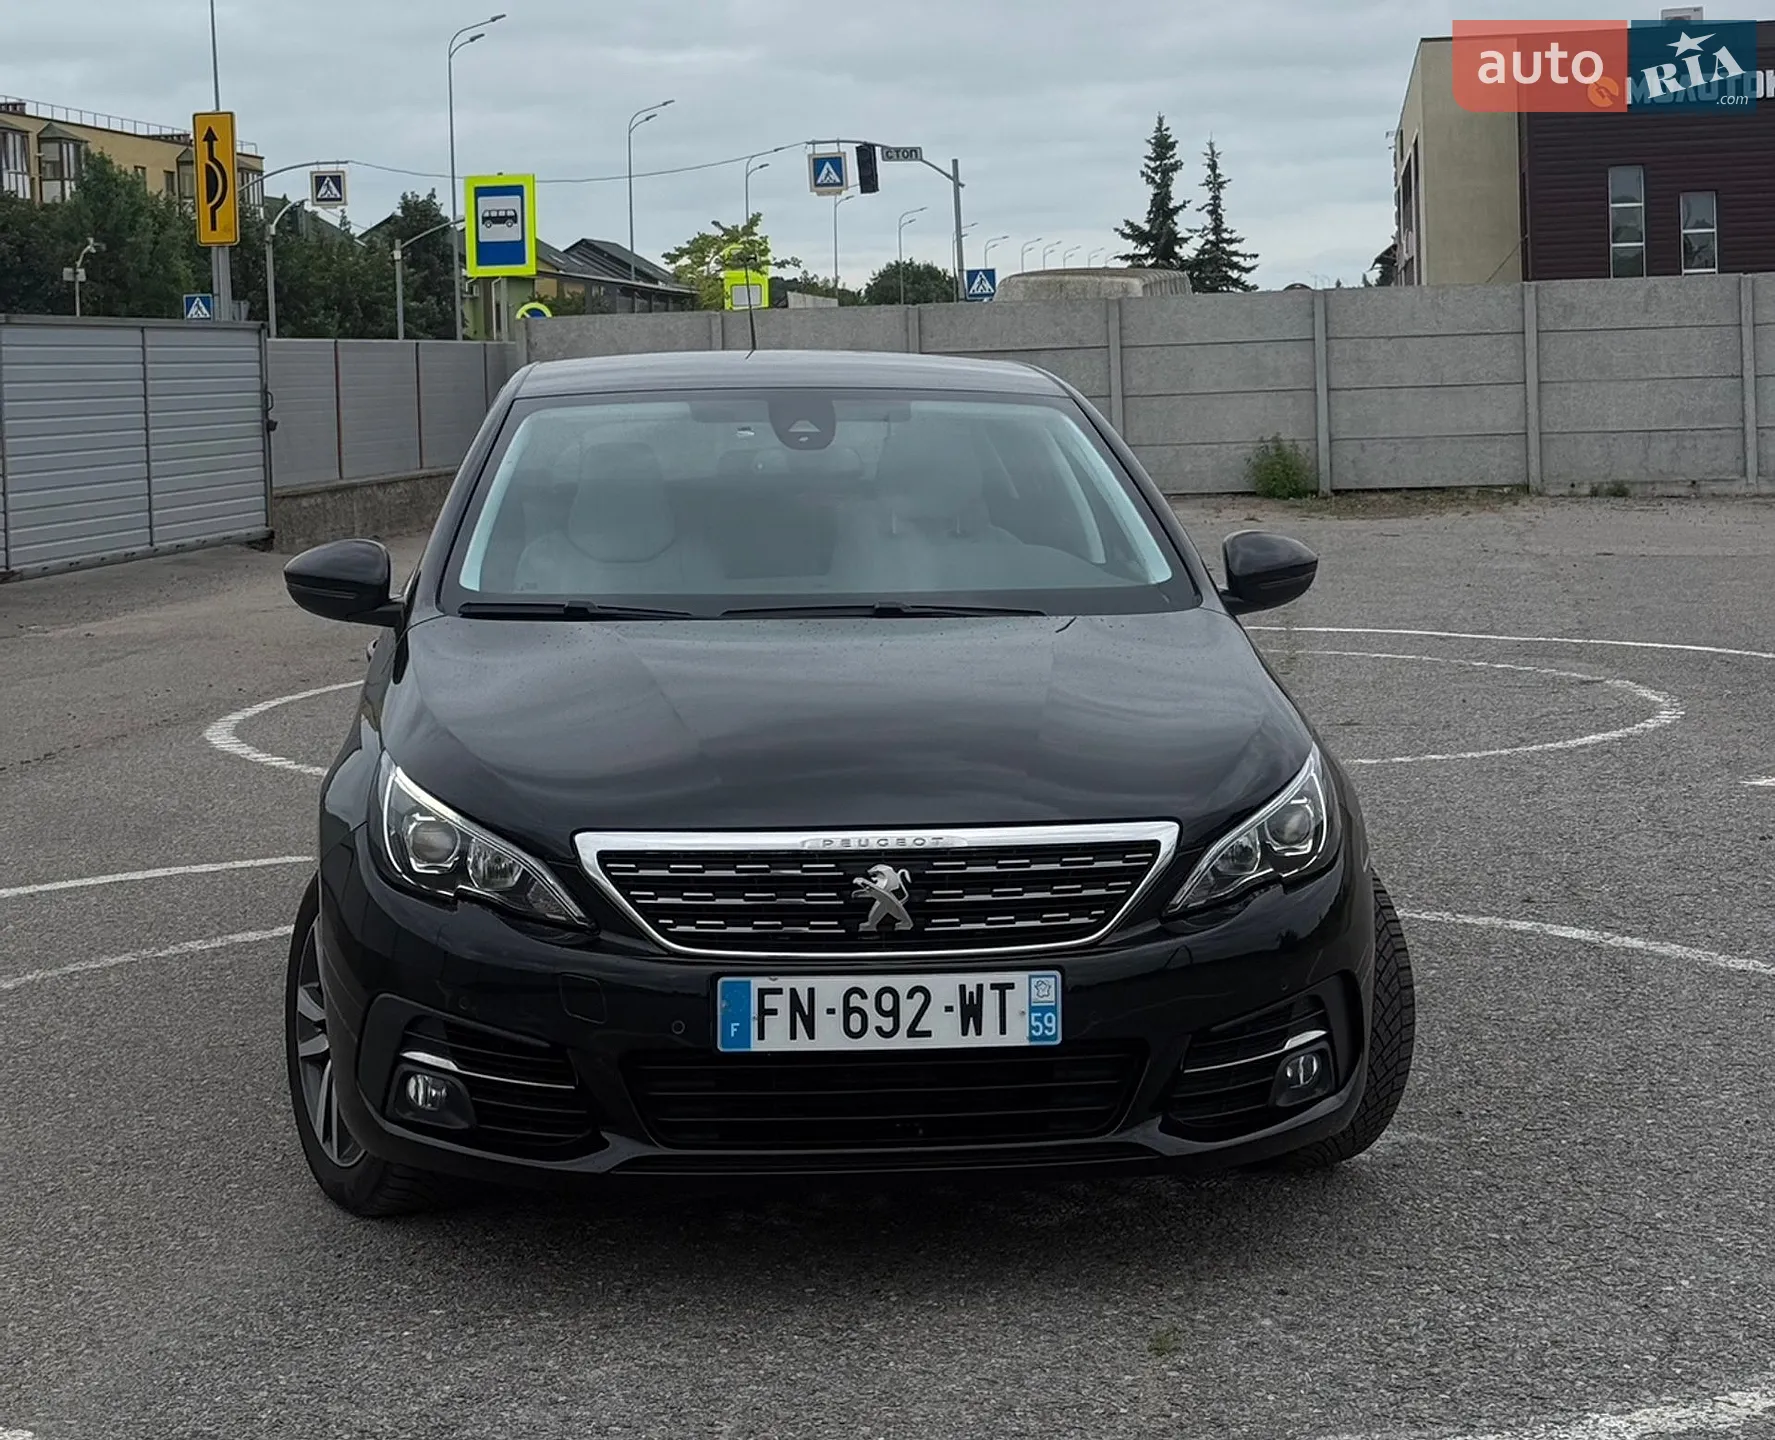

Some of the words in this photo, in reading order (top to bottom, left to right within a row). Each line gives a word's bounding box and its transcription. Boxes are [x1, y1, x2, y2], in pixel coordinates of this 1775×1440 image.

[885, 148, 918, 160] СТОП
[822, 836, 944, 848] PEUGEOT
[757, 982, 1016, 1041] FN-692-WT
[730, 1022, 740, 1037] F
[1030, 1012, 1057, 1037] 59
